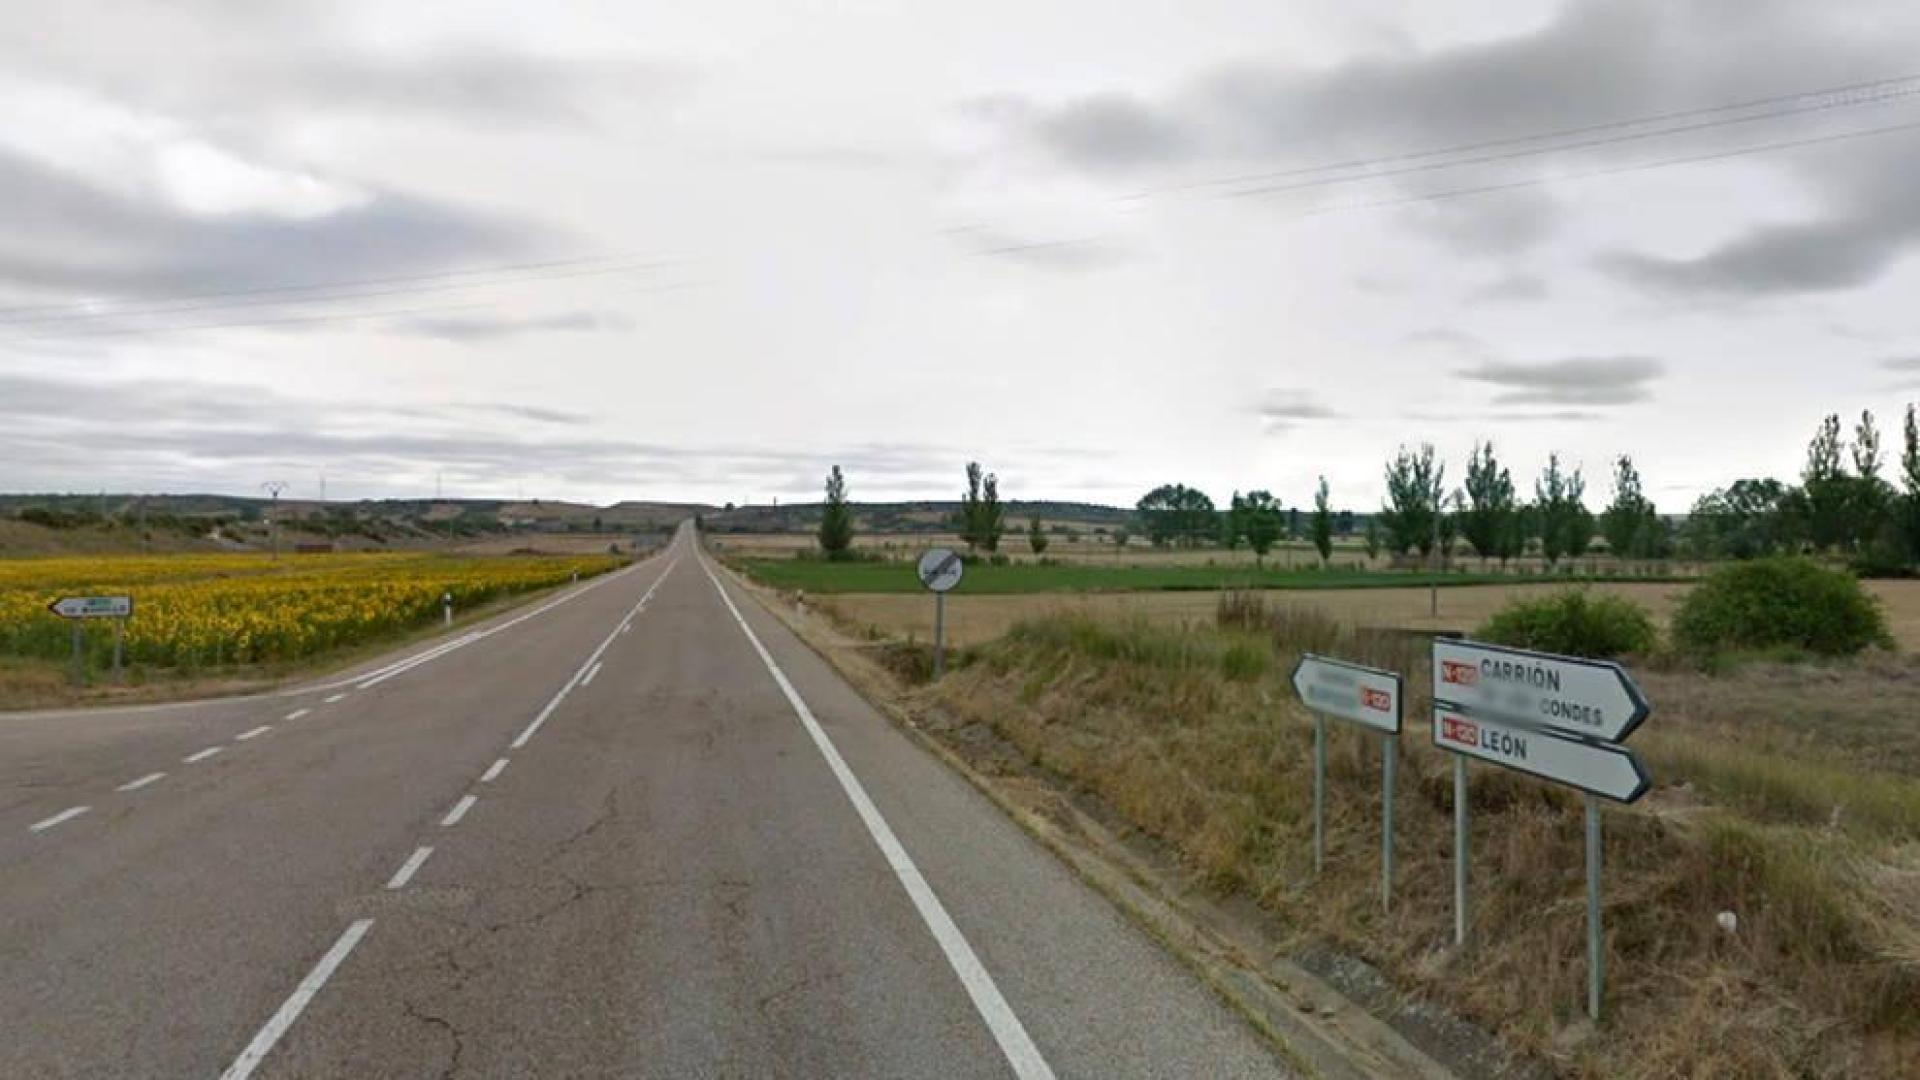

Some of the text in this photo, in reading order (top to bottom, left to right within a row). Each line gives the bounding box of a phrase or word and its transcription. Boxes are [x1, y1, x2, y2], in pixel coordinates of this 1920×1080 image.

[1481, 659, 1560, 692] CARRIÓN
[1540, 697, 1603, 726] CONDES
[1481, 728, 1527, 760] LEÓN
